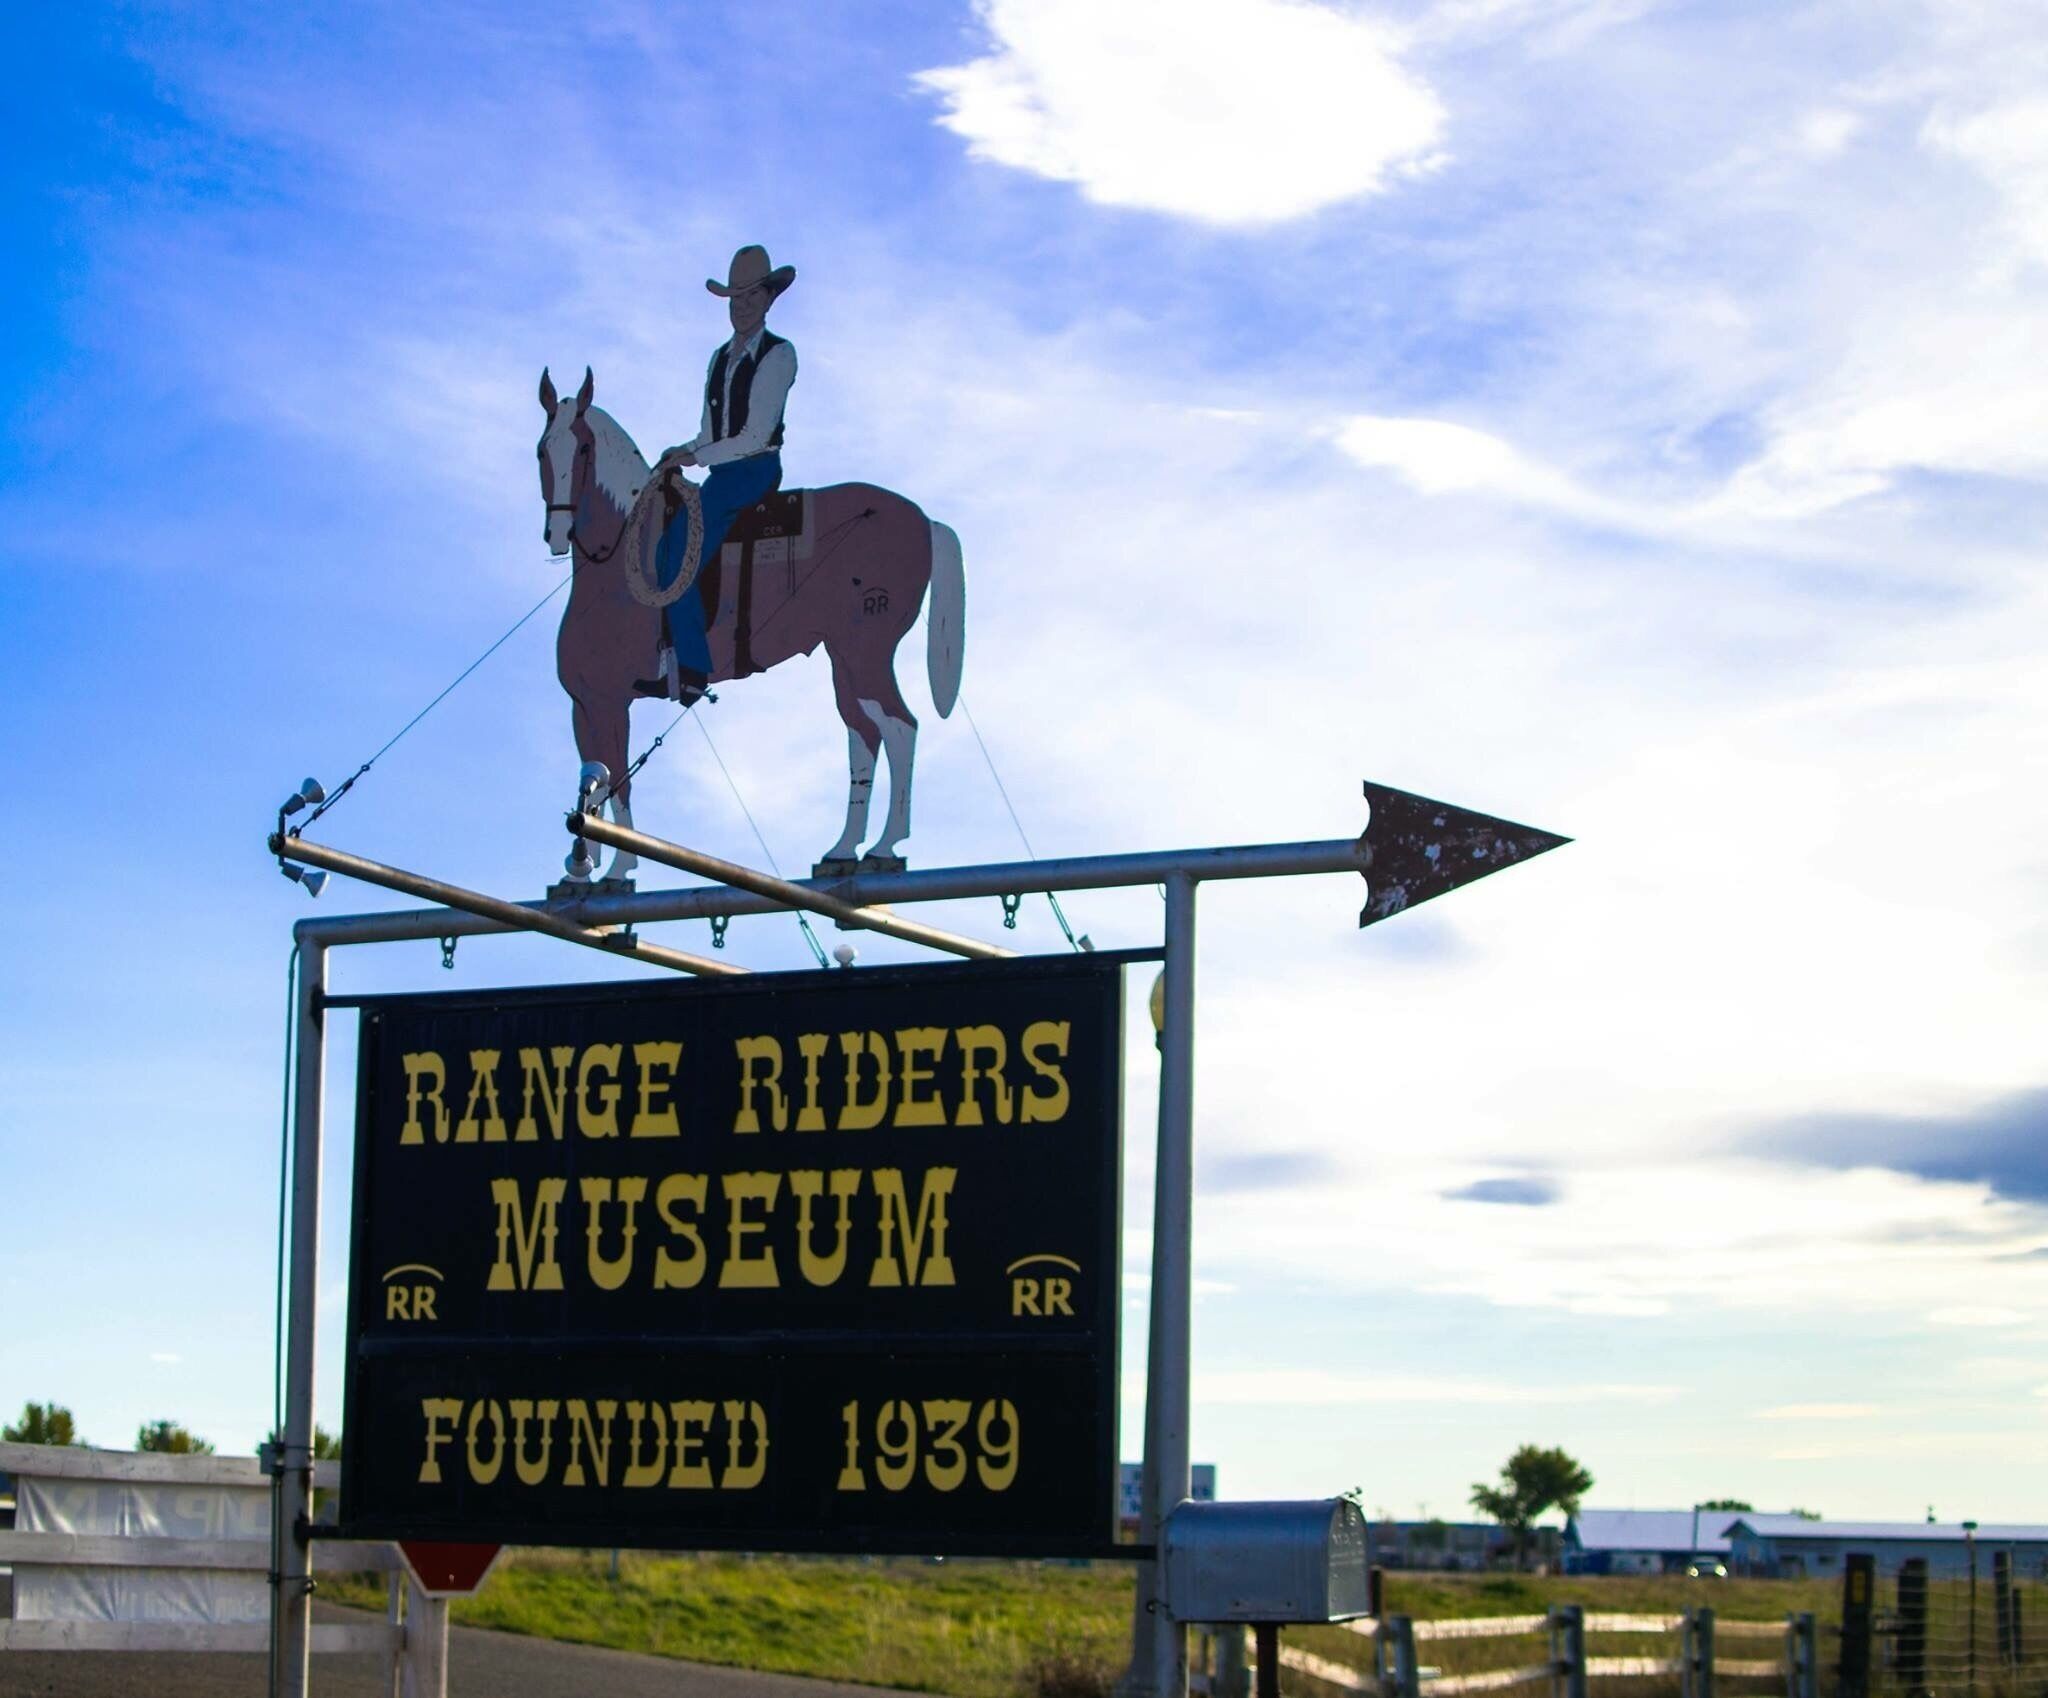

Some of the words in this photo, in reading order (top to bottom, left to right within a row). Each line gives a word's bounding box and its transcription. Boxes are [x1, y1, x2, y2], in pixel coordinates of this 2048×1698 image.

[399, 1041, 684, 1146] RANGE
[733, 1020, 1072, 1134] RIDERS
[486, 1166, 959, 1292] MUSEUM
[386, 1285, 438, 1321] RR
[1011, 1277, 1075, 1317] RR
[417, 1396, 770, 1490] FOUNDED
[836, 1397, 1020, 1492] 1939
